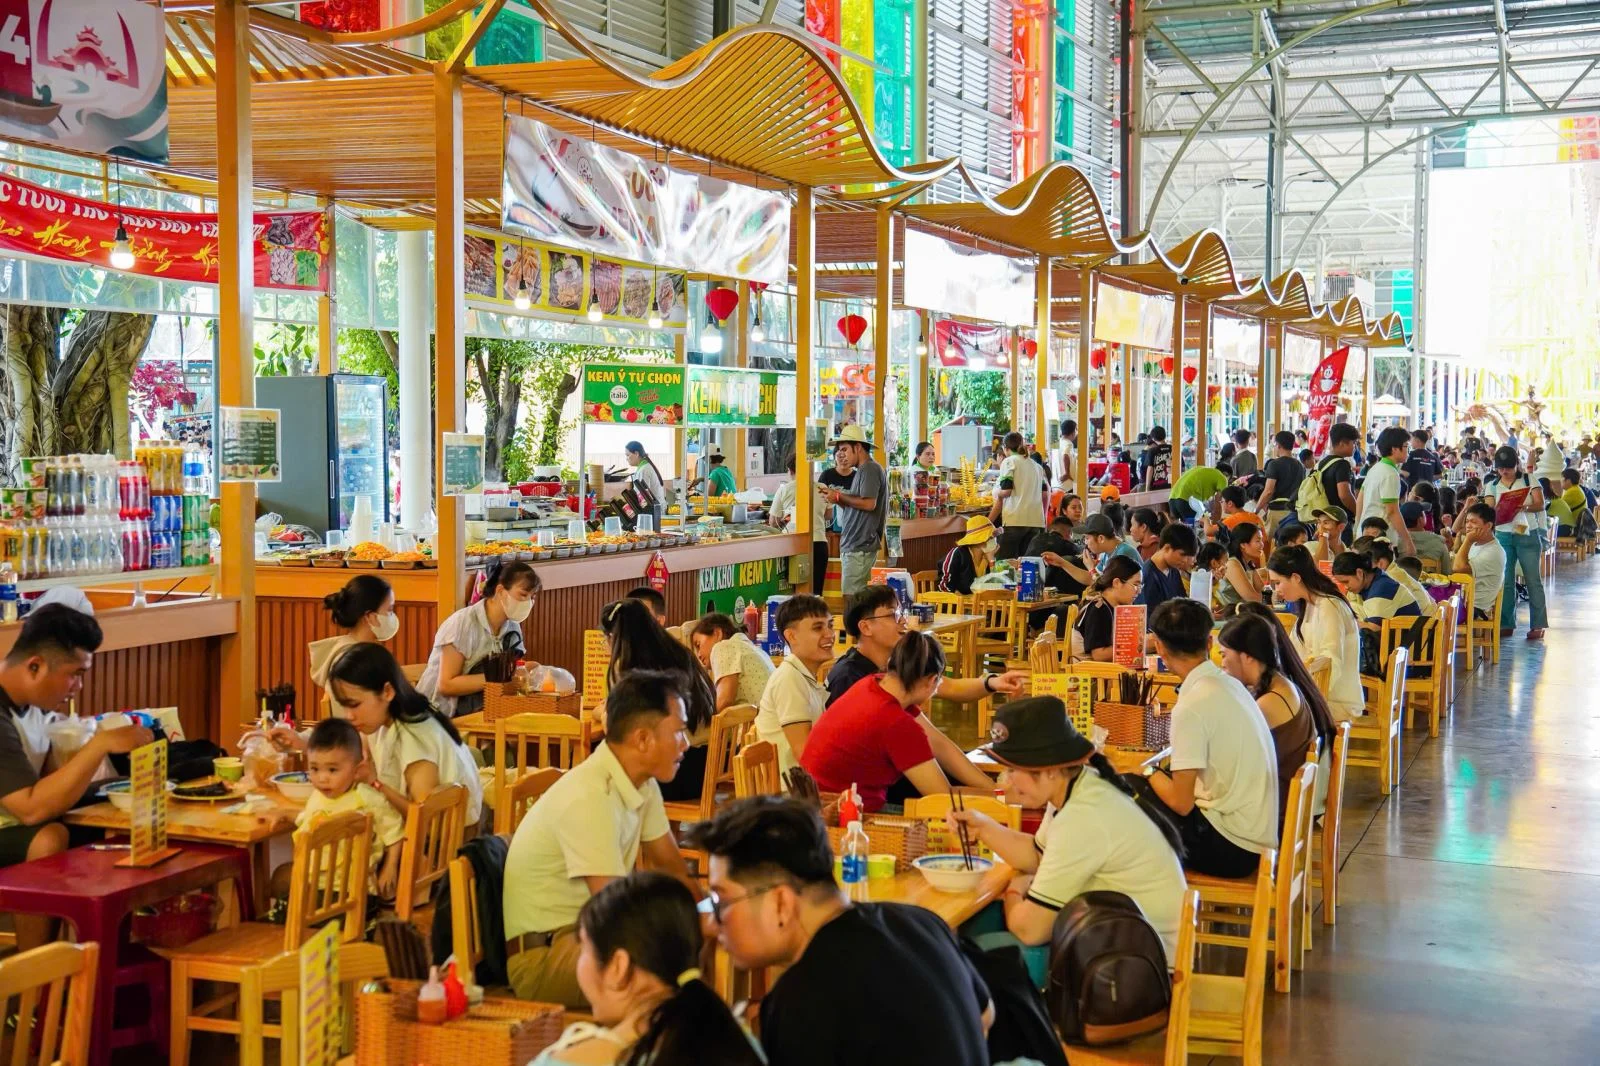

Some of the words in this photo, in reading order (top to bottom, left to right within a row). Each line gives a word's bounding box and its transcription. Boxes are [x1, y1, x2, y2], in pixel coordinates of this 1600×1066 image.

[587, 371, 615, 383] KEM
[617, 368, 626, 383] Ý
[628, 371, 646, 386] TỰ
[647, 372, 681, 387] CHỌN
[690, 381, 721, 414] KEM
[699, 567, 715, 593] KEM
[739, 560, 763, 586] KEM
